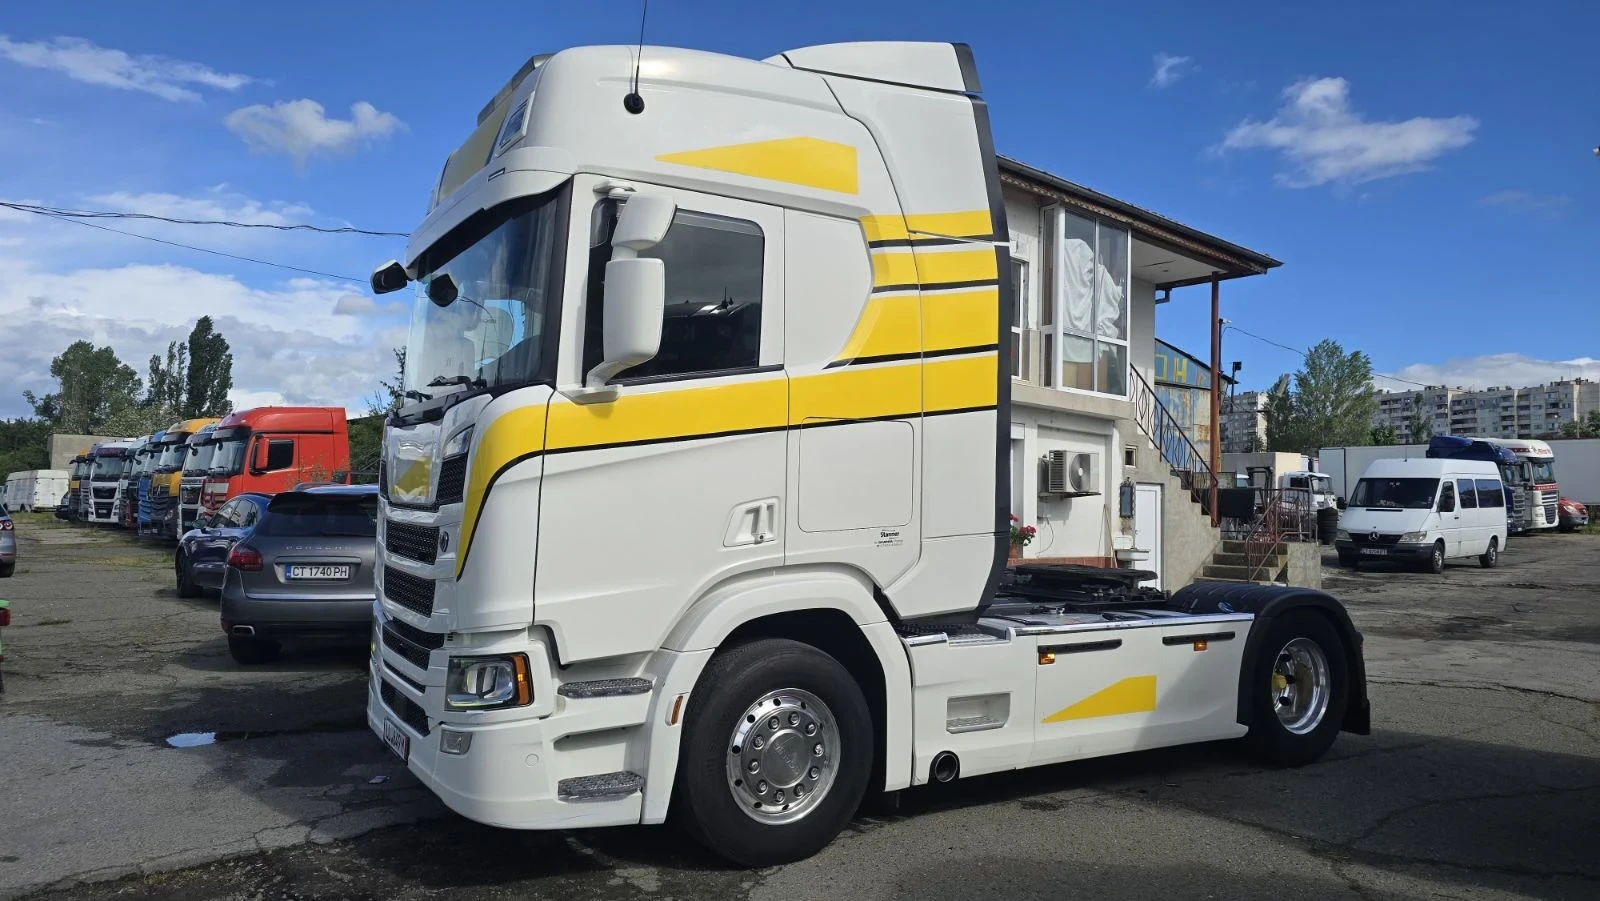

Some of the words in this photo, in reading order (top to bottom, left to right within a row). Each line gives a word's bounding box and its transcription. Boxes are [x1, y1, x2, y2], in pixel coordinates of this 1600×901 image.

[292, 566, 306, 577] CT
[309, 566, 332, 577] 1740
[333, 566, 348, 577] PH
